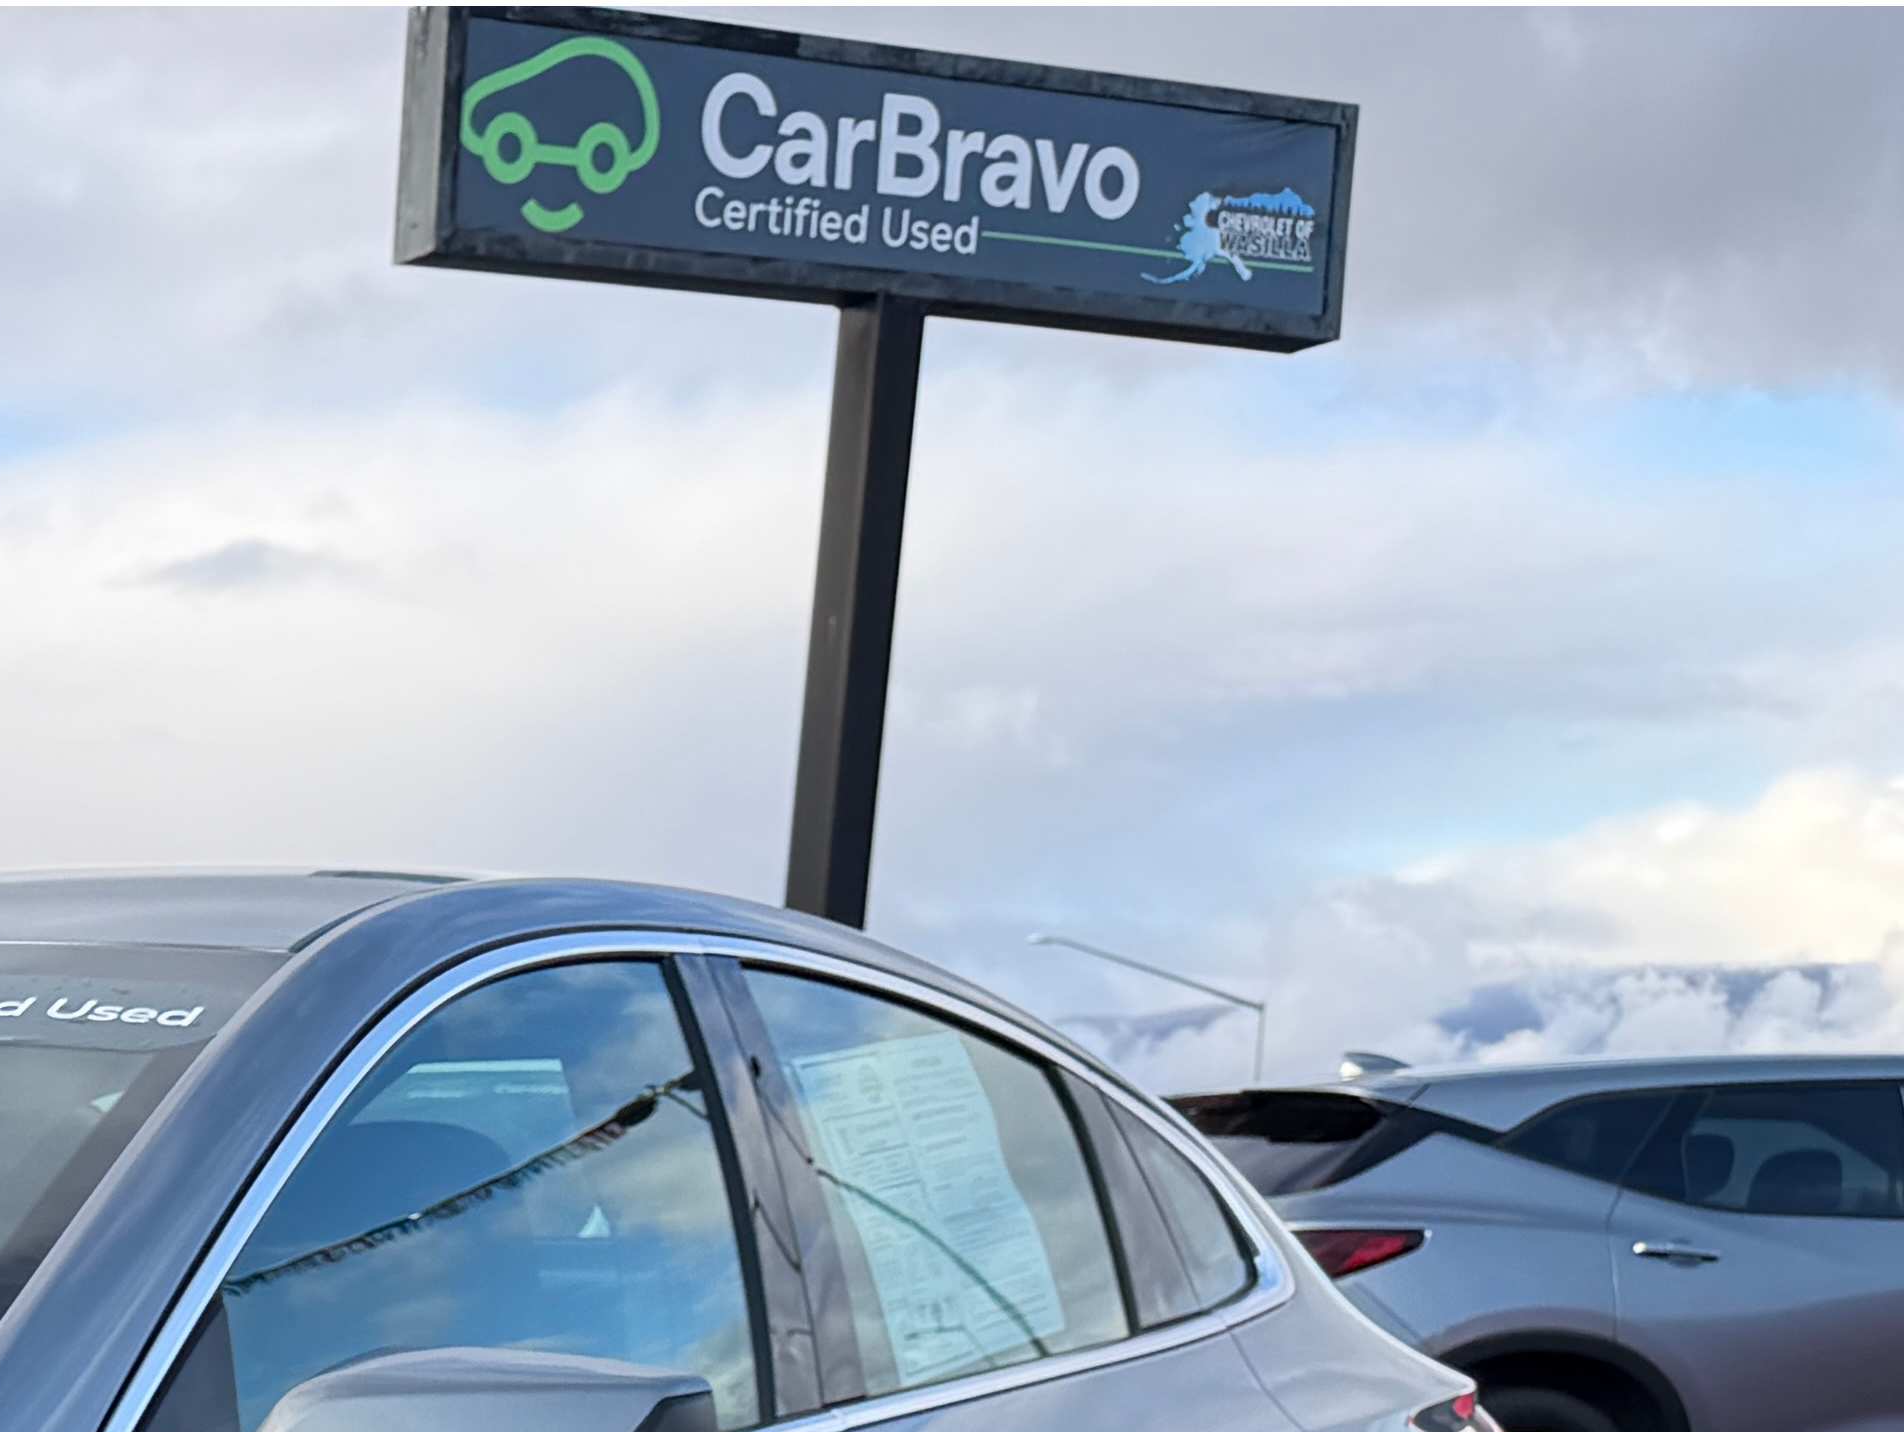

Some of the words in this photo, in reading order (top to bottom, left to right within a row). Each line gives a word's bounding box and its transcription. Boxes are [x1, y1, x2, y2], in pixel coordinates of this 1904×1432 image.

[701, 72, 1140, 220] CarBravo
[694, 186, 868, 243] Certified
[882, 206, 980, 255] Used
[47, 997, 204, 1028] Used
